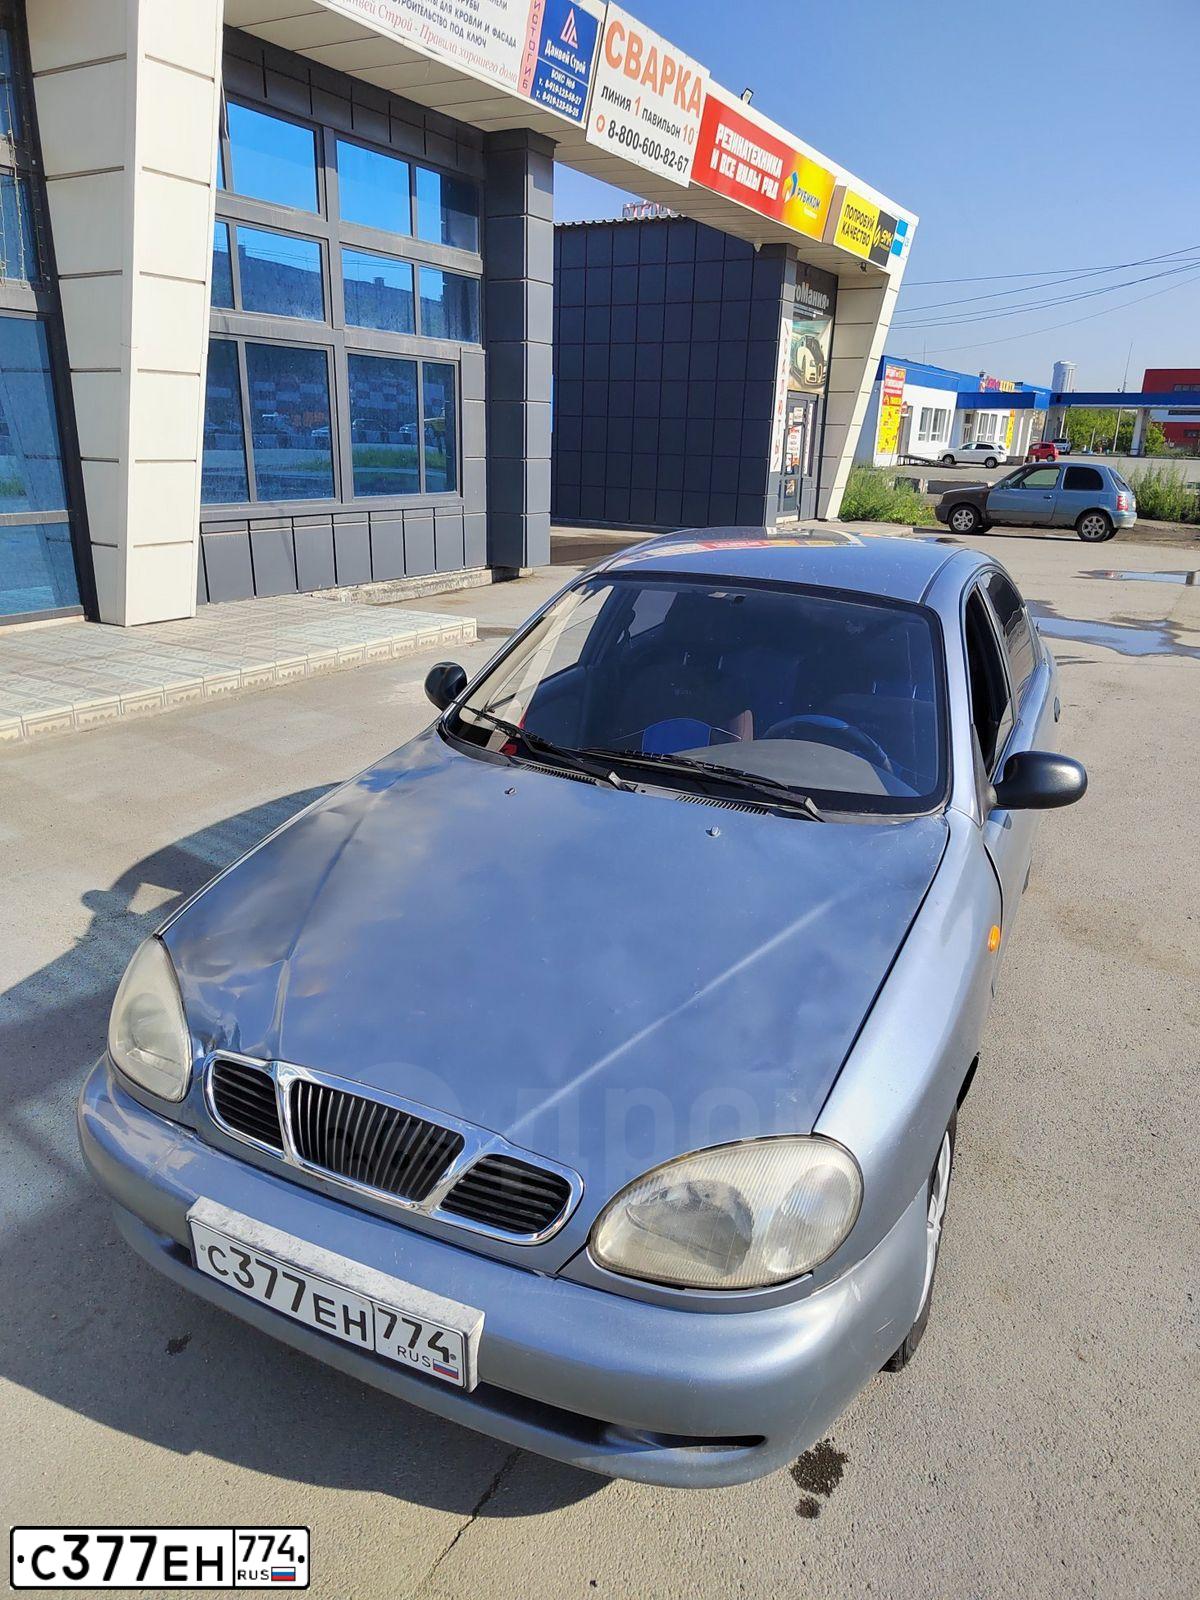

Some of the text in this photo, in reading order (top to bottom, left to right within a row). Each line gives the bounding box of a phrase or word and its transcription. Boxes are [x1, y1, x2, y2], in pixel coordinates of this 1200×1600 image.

[420, 24, 458, 54] Правила
[440, 2, 453, 14] ДЛЯ
[455, 8, 482, 30] КРОВЛИ
[484, 24, 490, 34] И
[492, 28, 516, 48] ФАСАДА
[449, 22, 464, 38] ПОД
[466, 31, 487, 48] КЛЮЧ
[605, 20, 702, 118] СВАРКА
[601, 85, 695, 145] ЛИНИЯ 1 ПАВИЛЬОН 10
[607, 120, 690, 174] 8-800-600-82-67
[710, 148, 720, 170] И
[719, 153, 737, 179] ВСЕ
[735, 162, 762, 192] ВИДЫ
[841, 221, 871, 247] КАЧЕСТВО
[844, 203, 876, 232] ПОПРОБУЙ
[377, 1307, 450, 1364] 774
[397, 1345, 431, 1368] RUS
